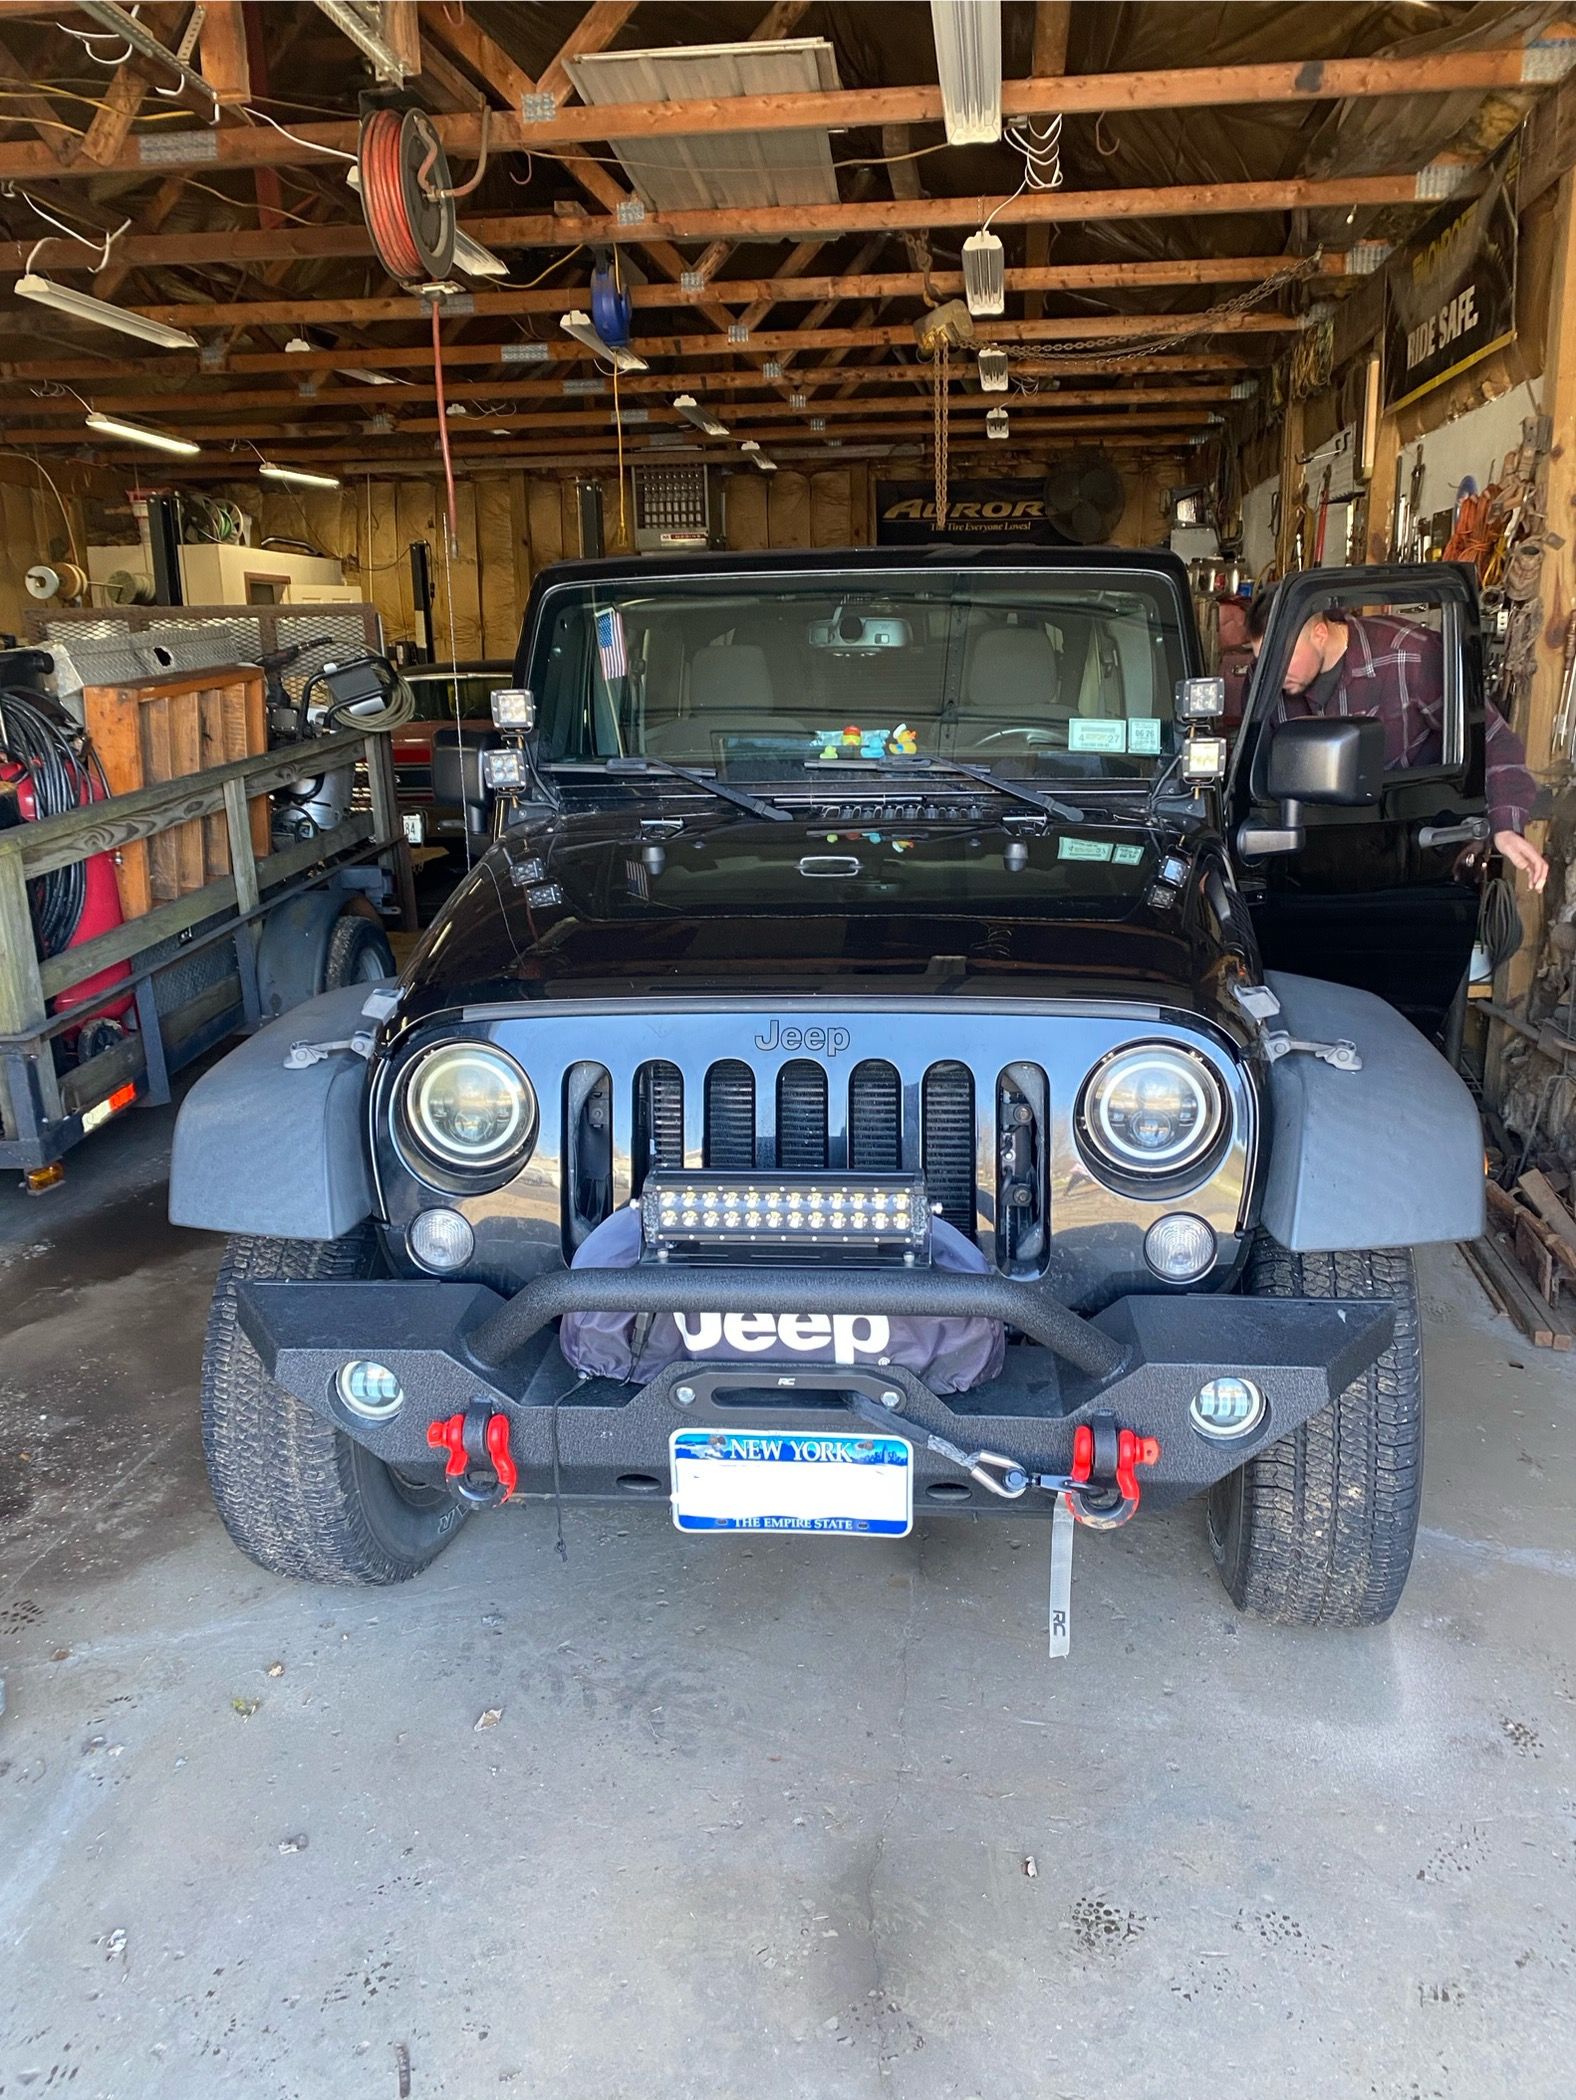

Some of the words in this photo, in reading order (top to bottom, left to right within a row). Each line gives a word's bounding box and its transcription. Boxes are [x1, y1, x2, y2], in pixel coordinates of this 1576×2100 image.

[1407, 316, 1436, 371] RIDE
[882, 498, 1049, 518] AUROR
[947, 522, 964, 531] Tire
[965, 521, 1003, 534] Everyone
[1107, 734, 1120, 743] 27
[754, 1019, 851, 1057] Jeep
[672, 1312, 890, 1364] Jeep
[777, 1377, 796, 1386] RC
[730, 1438, 783, 1460] NEW
[790, 1440, 853, 1463] YORK
[733, 1517, 760, 1528] THE
[763, 1517, 811, 1529] EMPIRE
[813, 1518, 852, 1530] STATE
[1052, 1609, 1066, 1637] RC
